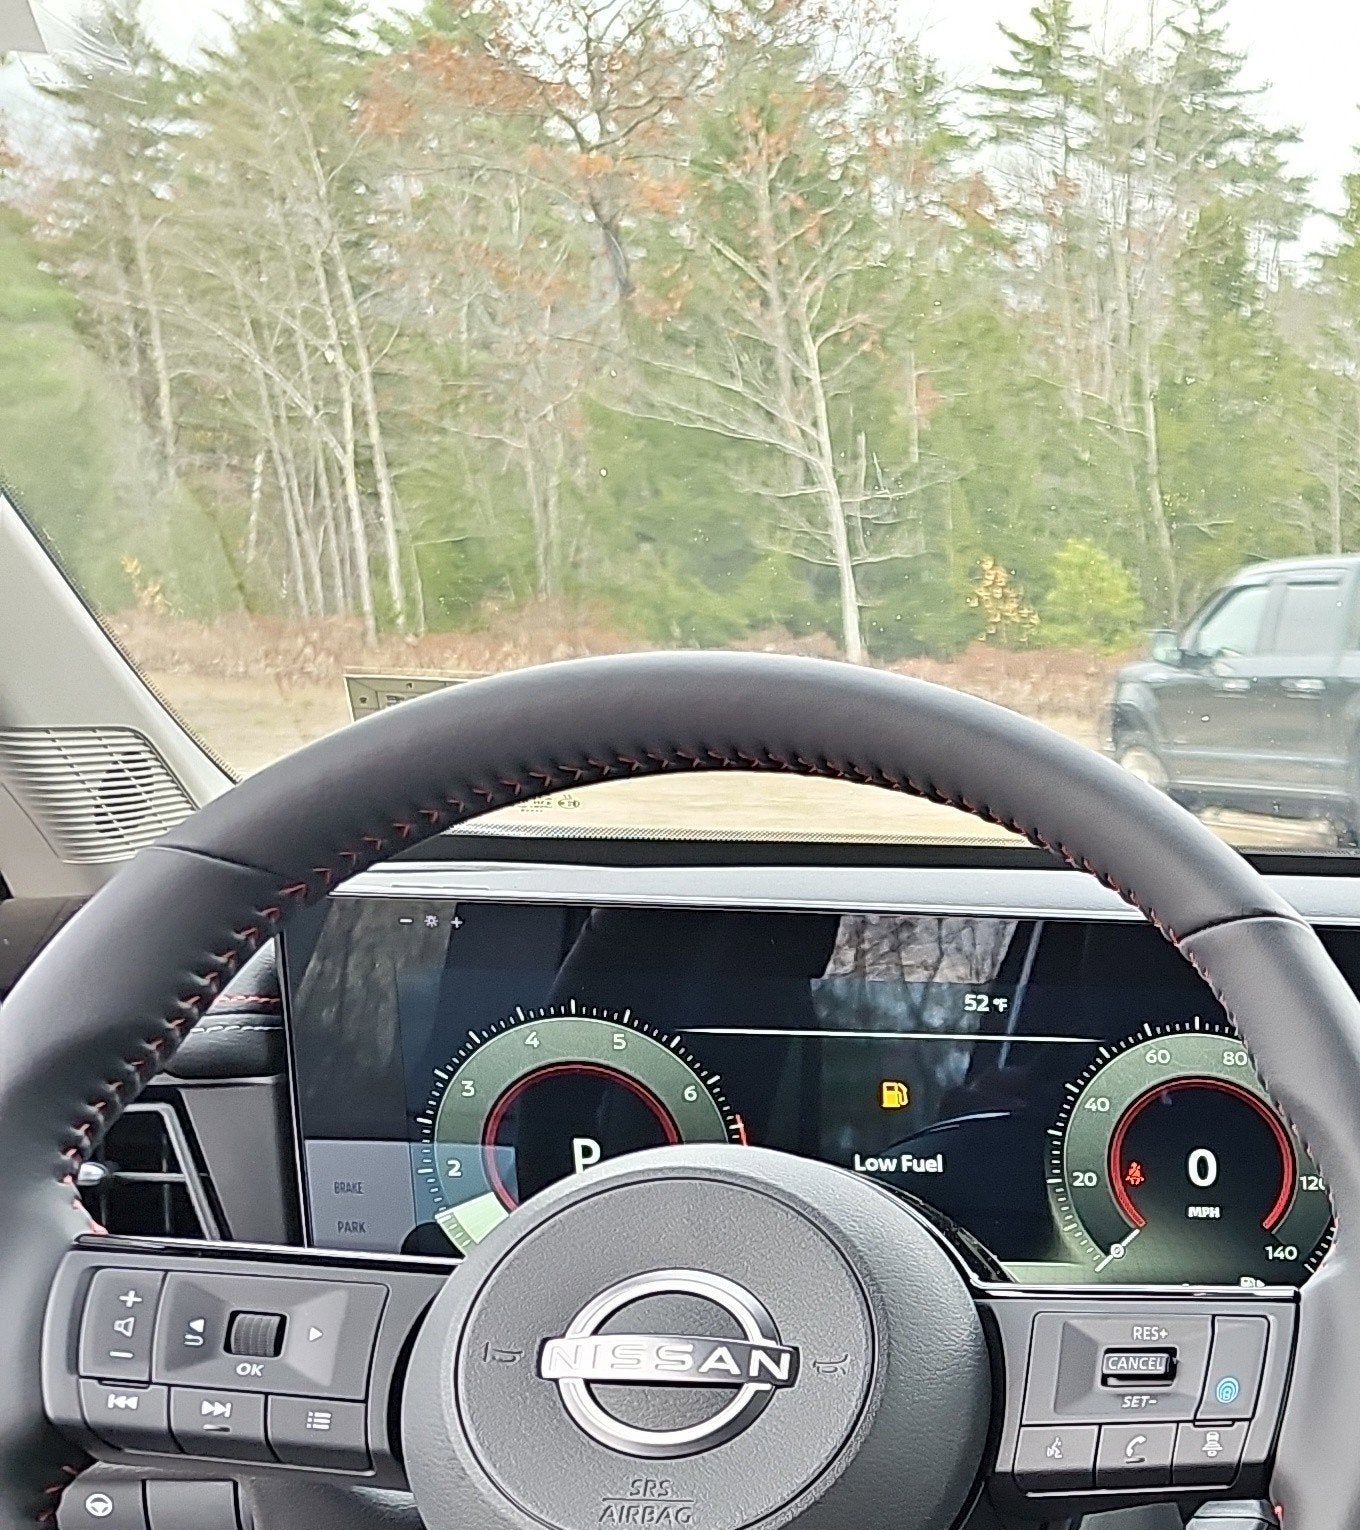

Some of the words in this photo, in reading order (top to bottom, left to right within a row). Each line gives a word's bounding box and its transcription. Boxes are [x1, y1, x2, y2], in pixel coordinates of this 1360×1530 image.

[964, 994, 1008, 1012] 52°F
[524, 1031, 540, 1048] 4
[612, 1034, 627, 1050] 5
[1145, 1049, 1171, 1065] 60
[1223, 1050, 1249, 1066] 80
[461, 1081, 475, 1097] 3
[684, 1085, 698, 1102] 6
[1085, 1097, 1110, 1113] 40
[573, 1138, 600, 1174] P
[854, 1154, 898, 1172] Low
[902, 1154, 943, 1173] Fuel
[447, 1160, 462, 1177] 2
[1187, 1148, 1217, 1187] 0
[1073, 1172, 1098, 1187] 20
[333, 1181, 364, 1195] BRAKE
[1188, 1206, 1220, 1219] MPH
[336, 1221, 366, 1234] PARK
[1265, 1245, 1298, 1261] 140
[548, 1343, 791, 1380] NISSAN
[1108, 1357, 1164, 1371] CANCEL
[236, 1363, 264, 1377] OK
[630, 1478, 674, 1498] SRS
[599, 1504, 695, 1525] AIRBAG
